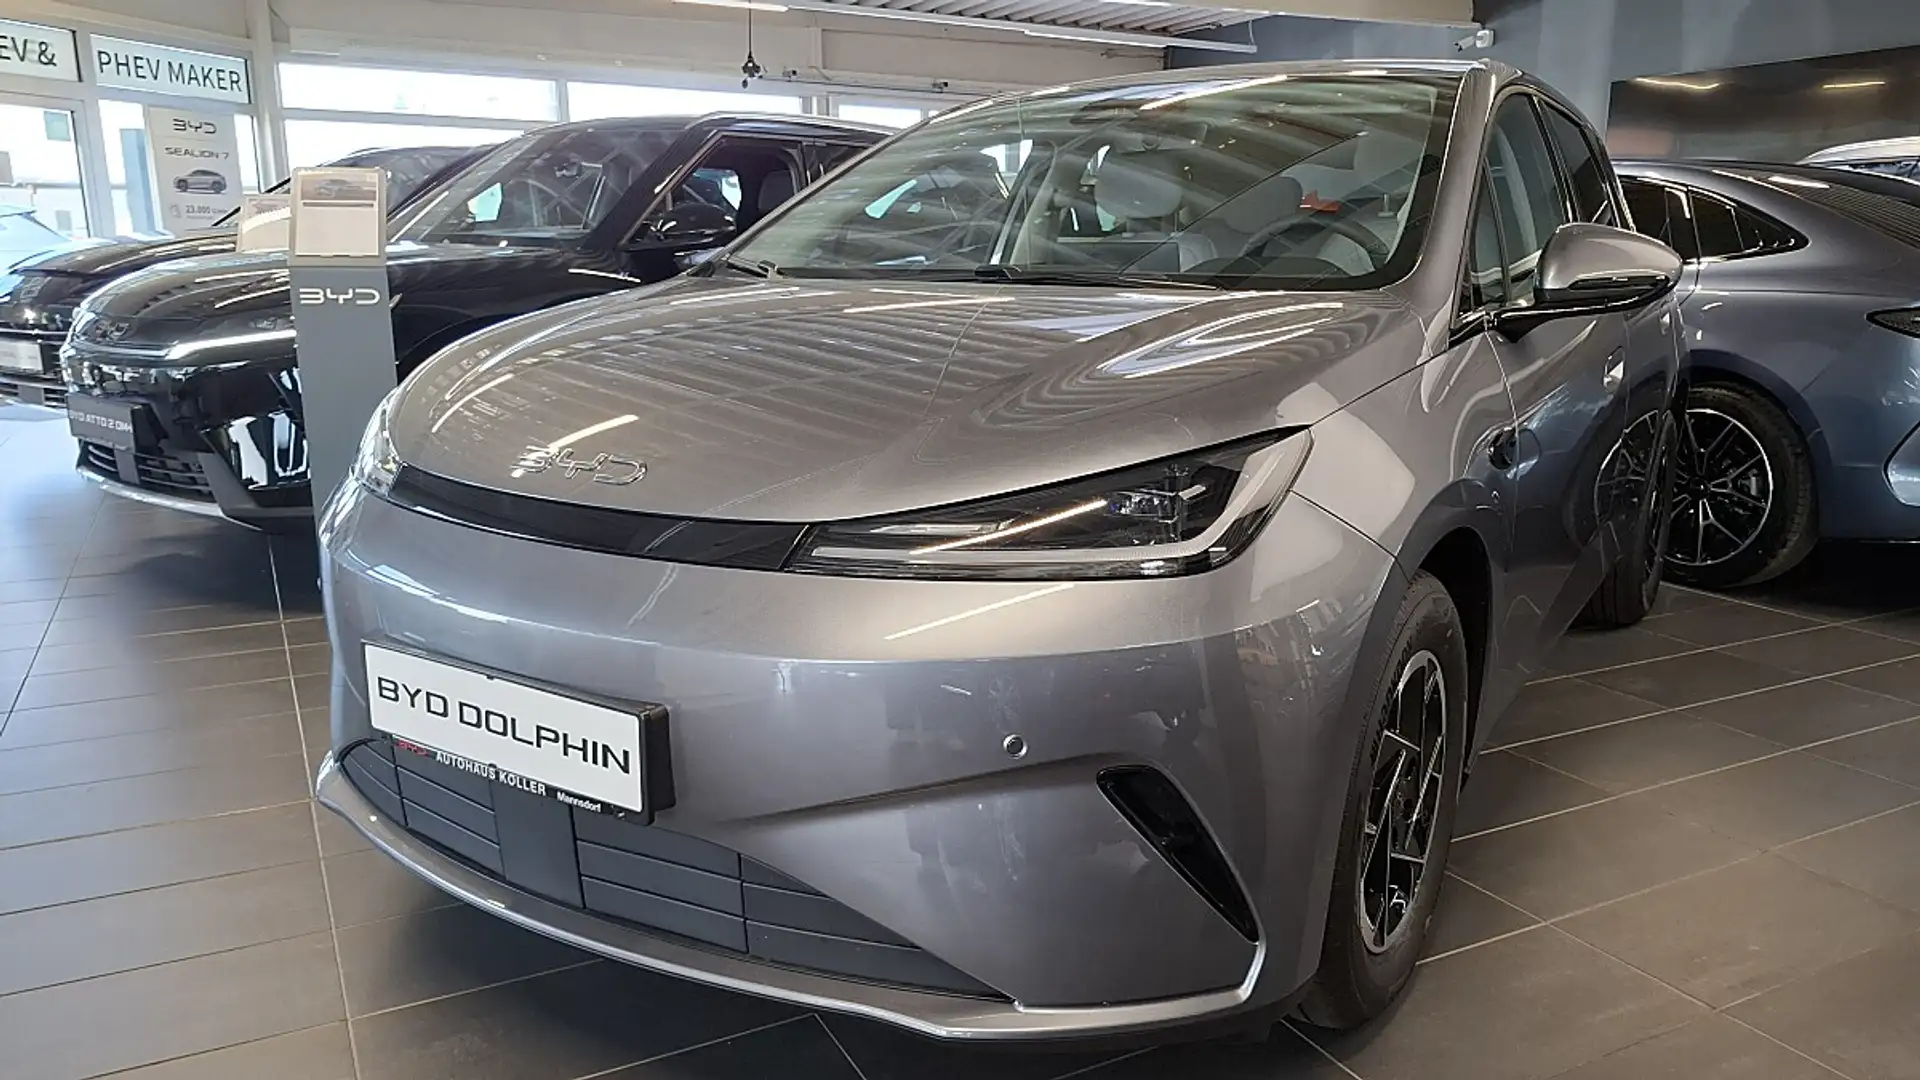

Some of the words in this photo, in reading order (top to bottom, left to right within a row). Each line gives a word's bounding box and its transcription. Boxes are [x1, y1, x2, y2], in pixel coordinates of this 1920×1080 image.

[38, 41, 57, 67] &
[97, 50, 160, 81] PHEV
[168, 60, 242, 92] MAKER
[172, 118, 217, 134] BYD
[164, 147, 220, 159] SEALION
[222, 151, 230, 160] 7
[299, 287, 380, 305] BYD
[510, 444, 648, 486] BYD
[377, 676, 449, 719] BYD
[458, 700, 631, 775] DOLPHIN
[435, 750, 496, 780] AUTOHAUS
[499, 769, 547, 797] KOLLER
